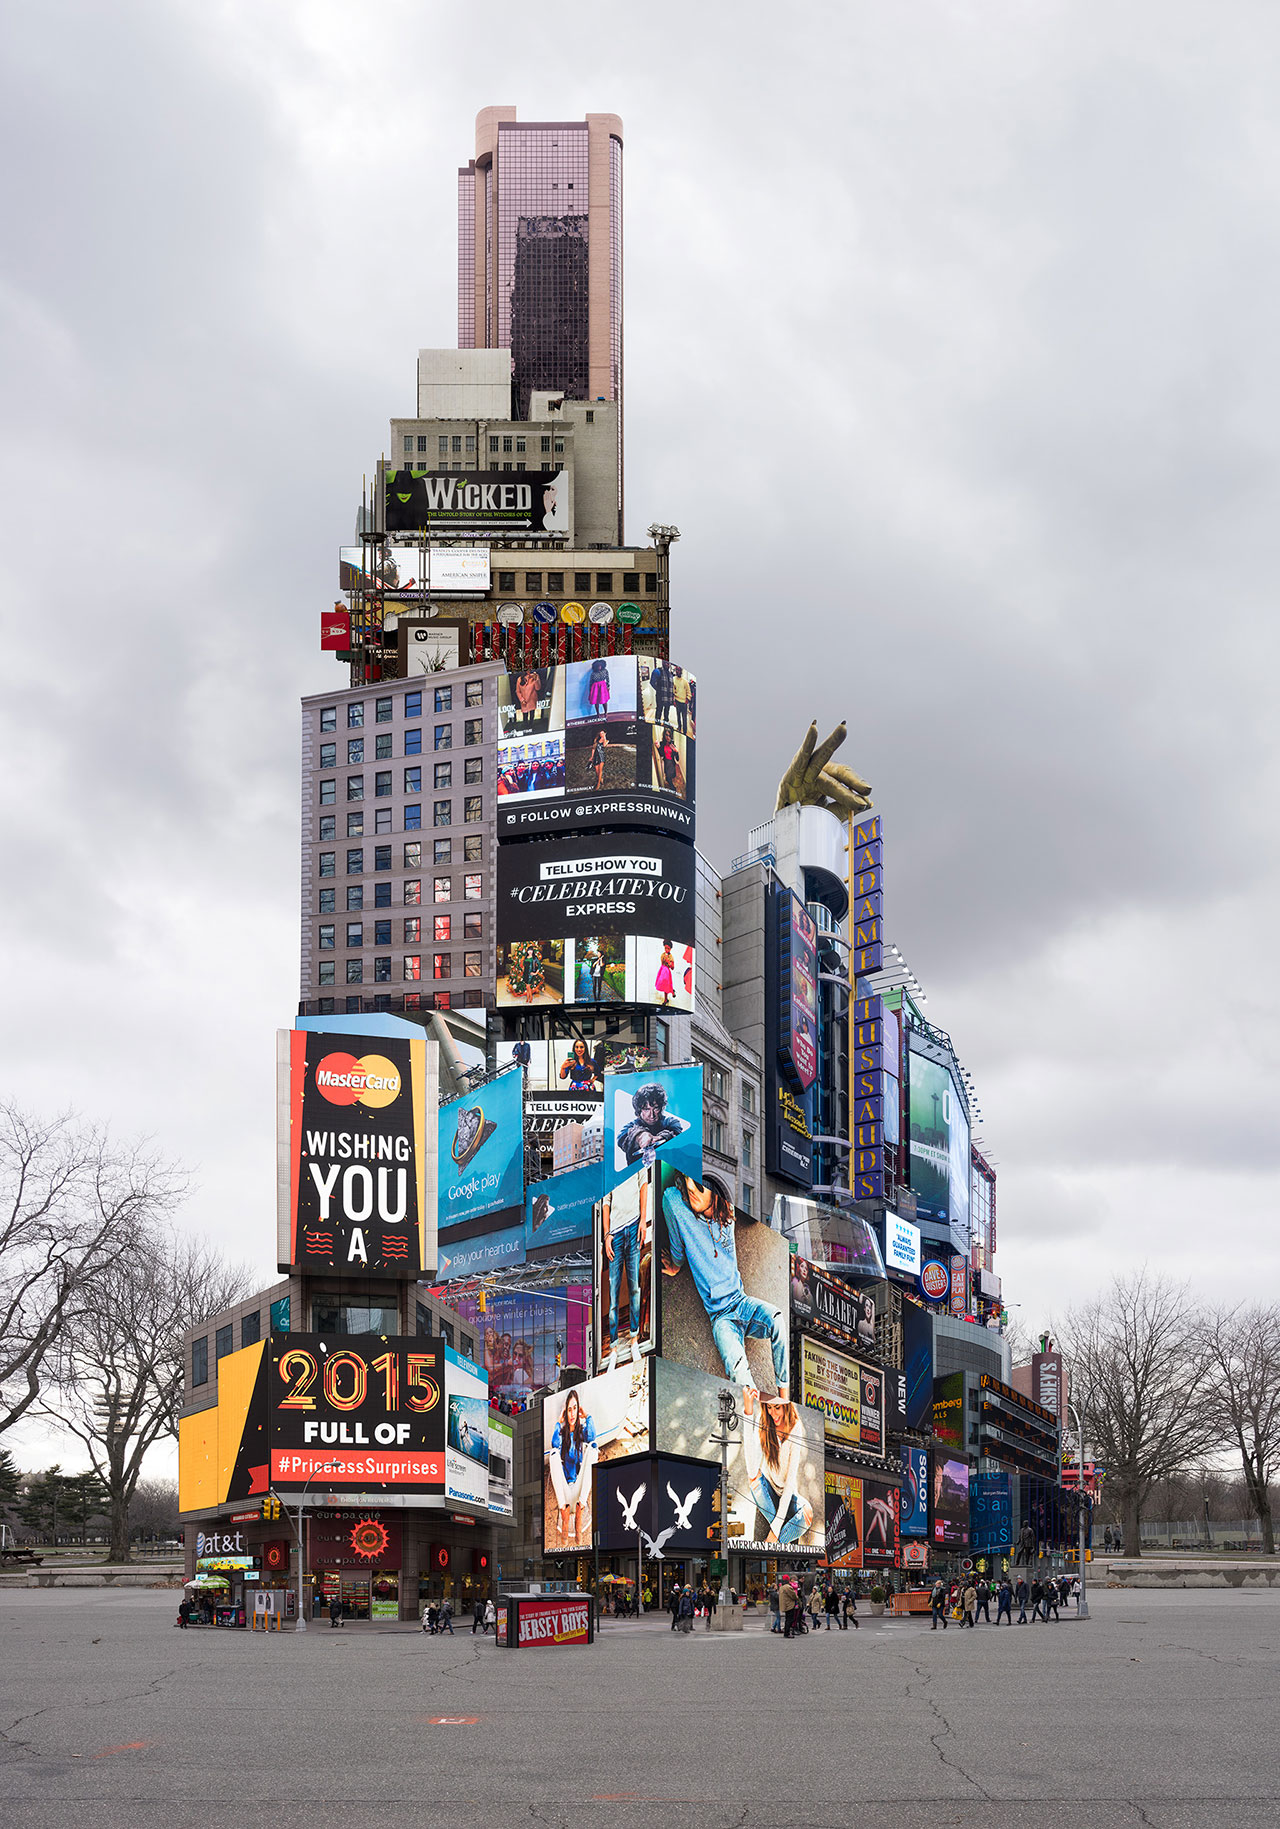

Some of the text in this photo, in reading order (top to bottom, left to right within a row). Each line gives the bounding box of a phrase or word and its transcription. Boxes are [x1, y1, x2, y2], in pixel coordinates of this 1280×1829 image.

[422, 477, 532, 511] WICKED
[520, 802, 692, 824] FOLLOW @EXPRESSRUNWAY
[546, 860, 658, 876] TELL US HOW YOU
[510, 878, 687, 904] #CELEBRATEYOU
[856, 817, 878, 971] MADAME
[566, 902, 636, 916] EXPRESS
[318, 1070, 400, 1090] MasterCard
[530, 1103, 597, 1112] TELL US HOW
[306, 1130, 409, 1162] WISHING
[308, 1162, 407, 1224] YOU
[448, 1172, 501, 1200] Google play
[347, 1228, 368, 1262] A
[453, 1240, 520, 1268] play your heart out
[924, 1270, 940, 1282] DAVE
[952, 1273, 964, 1282] EAT
[504, 1309, 527, 1320] winter
[530, 1304, 555, 1317] blues.
[816, 1281, 858, 1330] CABARET
[804, 1350, 858, 1381] TAKING THE WORLD
[816, 1365, 825, 1376] BY
[277, 1348, 440, 1413] 2015
[861, 1370, 880, 1387] Avenue
[865, 1382, 876, 1406] Q
[898, 1375, 906, 1415] NEW
[805, 1392, 858, 1426] MOTOWN
[304, 1421, 411, 1445] FULL OF
[278, 1456, 438, 1479] #PricelessSurprises
[448, 1486, 486, 1505] Panasonic.com
[919, 1503, 927, 1512] 2
[204, 1531, 244, 1554] at&t
[767, 1542, 788, 1552] EAGLE
[789, 1544, 826, 1554] OUTFITTERS
[519, 1610, 588, 1642] JERSEY BOYS
